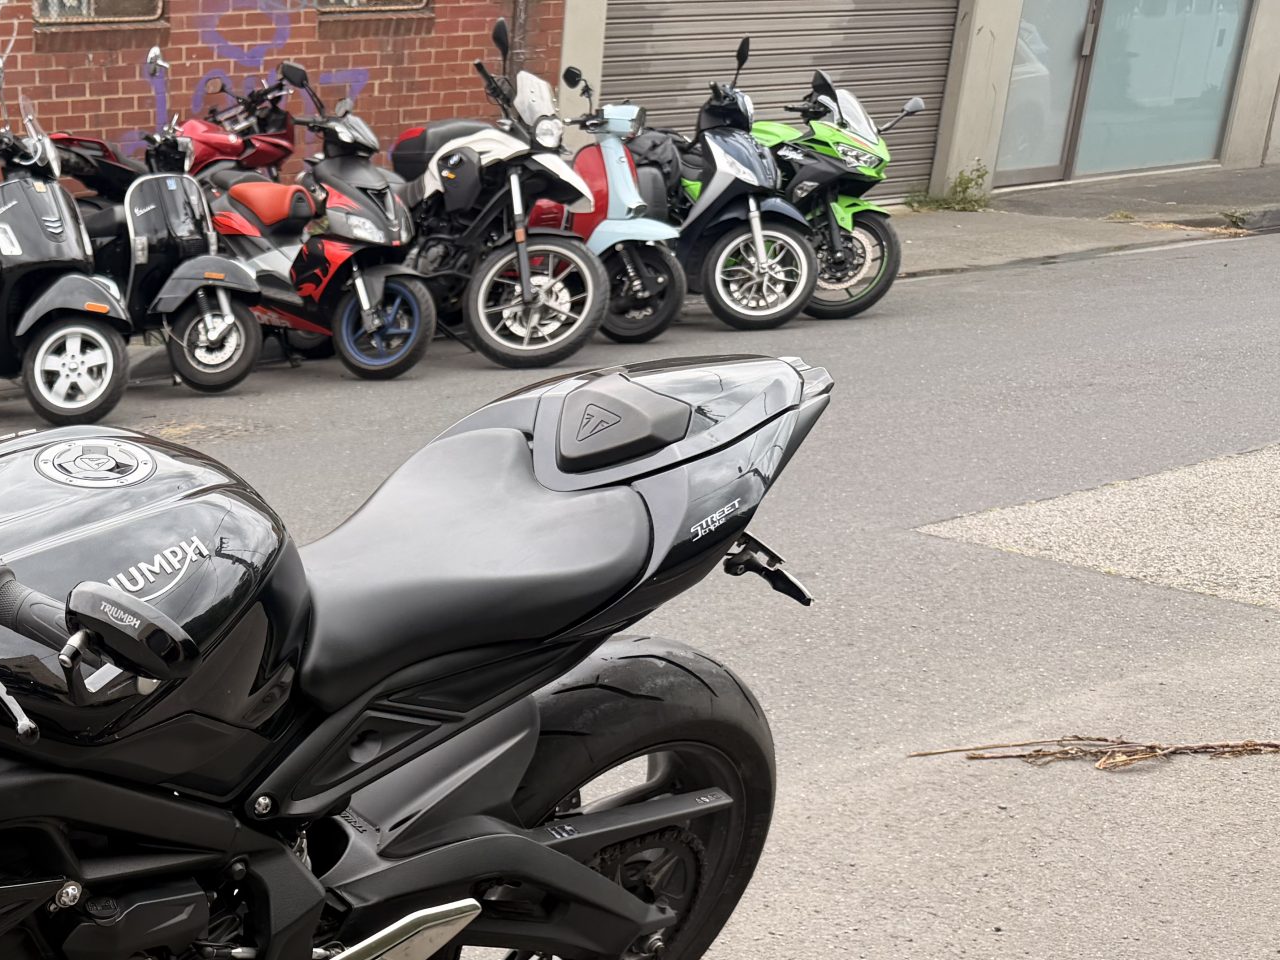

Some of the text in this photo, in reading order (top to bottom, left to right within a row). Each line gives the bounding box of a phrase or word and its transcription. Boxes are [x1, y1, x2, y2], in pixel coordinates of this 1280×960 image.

[690, 497, 742, 542] STREET
[106, 535, 210, 596] IUMPH
[100, 601, 141, 629] TRIUMPH
